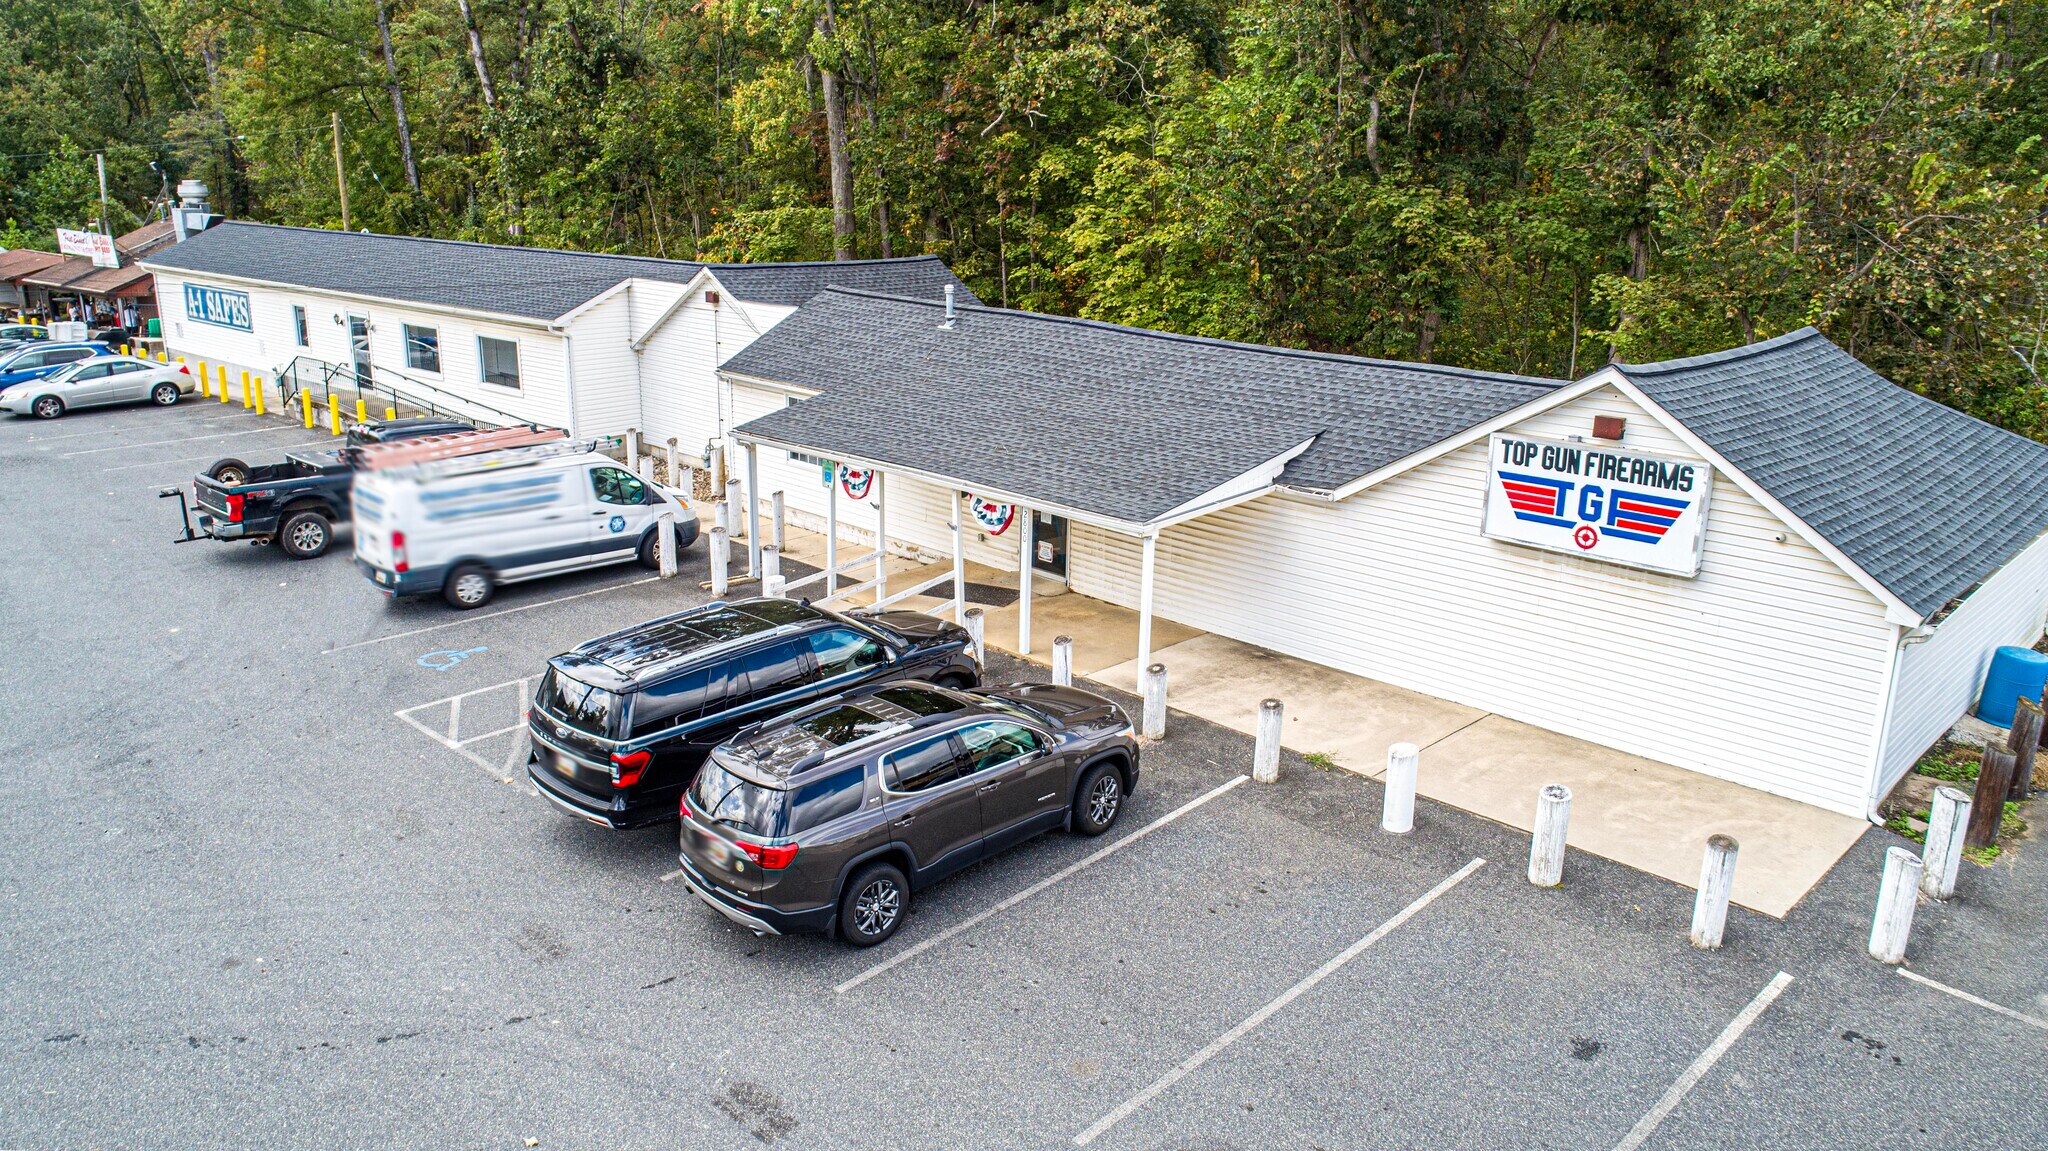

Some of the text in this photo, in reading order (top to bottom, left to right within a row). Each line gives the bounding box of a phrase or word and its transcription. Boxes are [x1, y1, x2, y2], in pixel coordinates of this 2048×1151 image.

[188, 288, 249, 328] A-1 SAFES
[1502, 440, 1694, 492] TOP GUN FIREARMS
